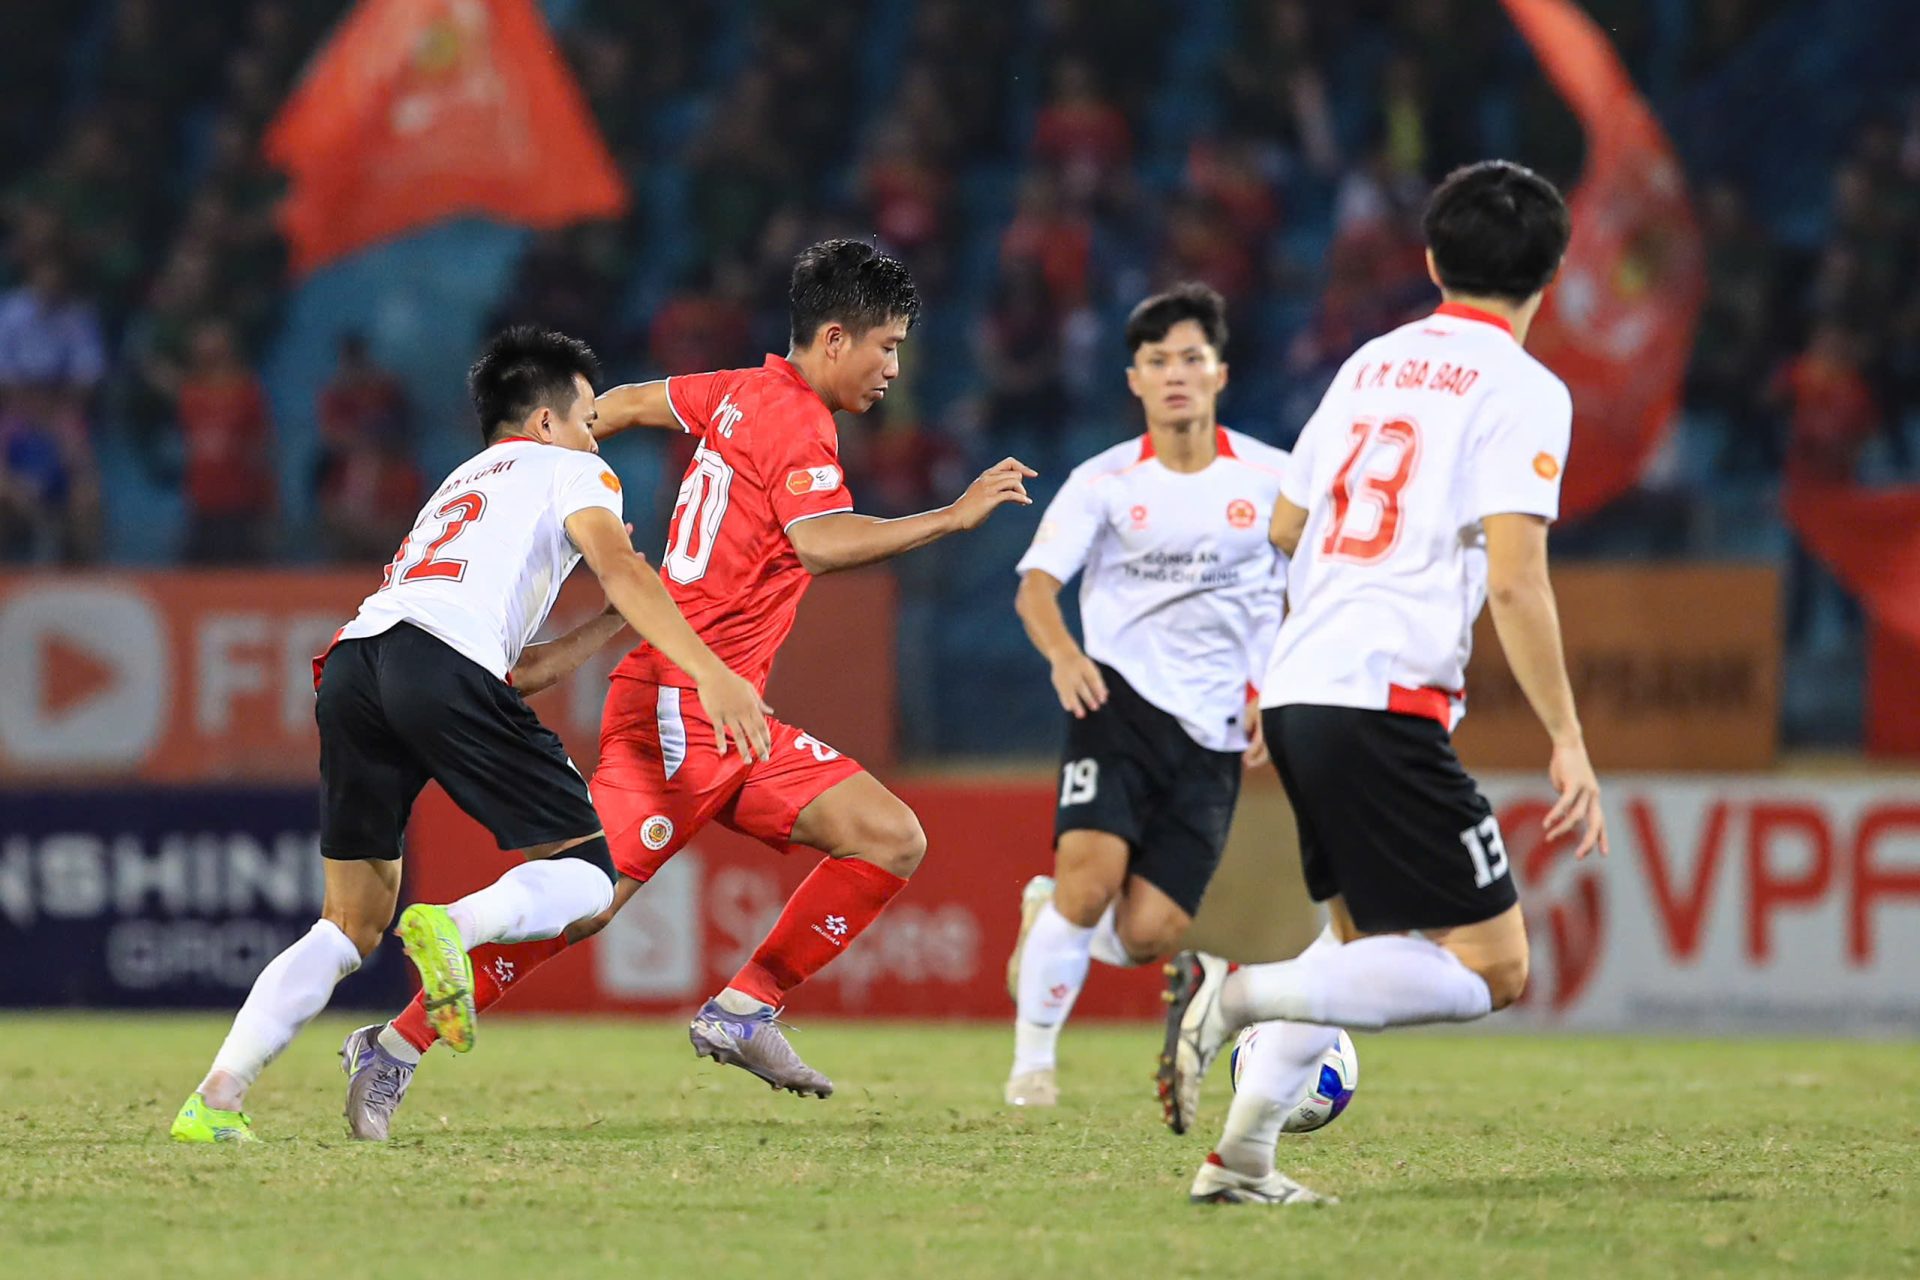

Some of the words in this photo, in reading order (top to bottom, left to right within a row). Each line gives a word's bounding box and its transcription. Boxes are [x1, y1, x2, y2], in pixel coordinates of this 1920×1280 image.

[1318, 416, 1424, 568] 13
[1059, 757, 1099, 808] 19
[1458, 814, 1510, 889] 13
